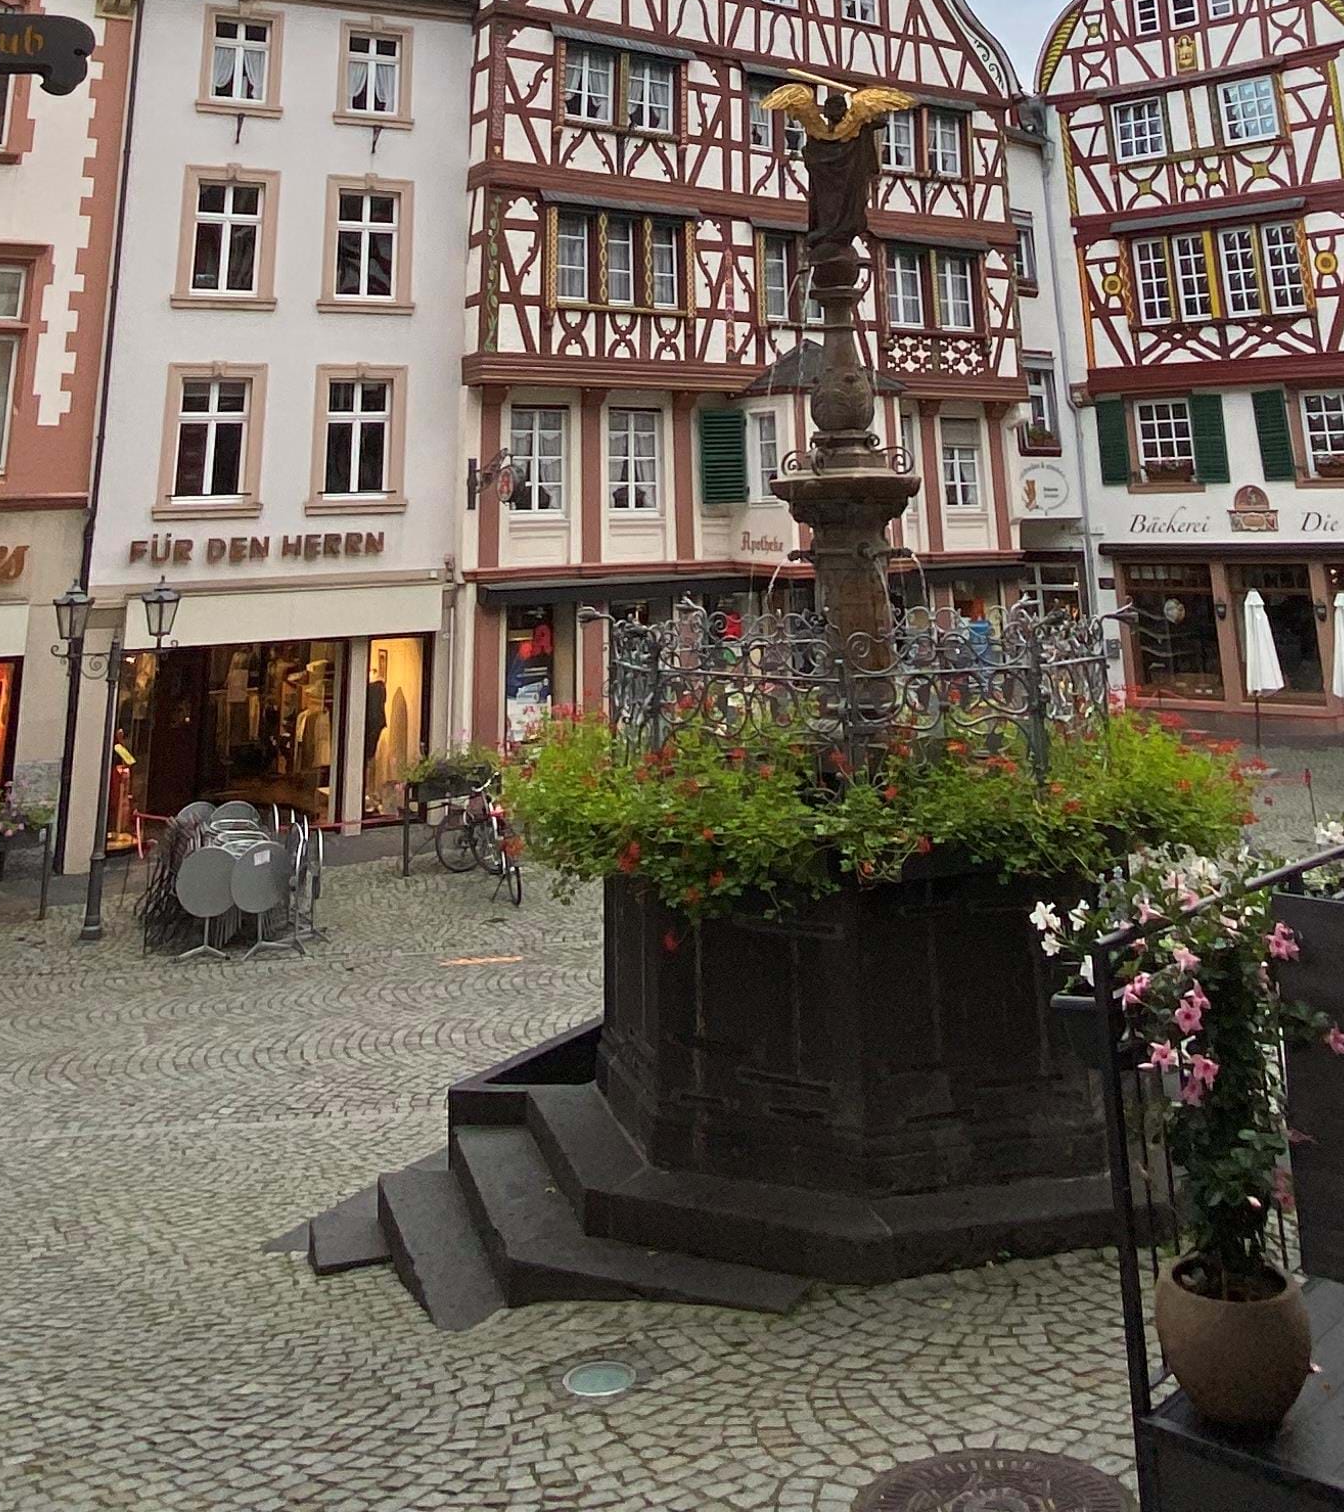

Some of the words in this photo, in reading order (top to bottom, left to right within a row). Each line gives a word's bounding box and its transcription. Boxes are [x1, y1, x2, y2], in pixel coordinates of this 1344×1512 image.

[1128, 506, 1210, 534] Bäckerei
[1300, 510, 1339, 533] Die
[129, 533, 194, 565] FÜR
[207, 536, 271, 565] DEN
[281, 532, 385, 560] HERRN
[741, 531, 784, 555] Apotheke
